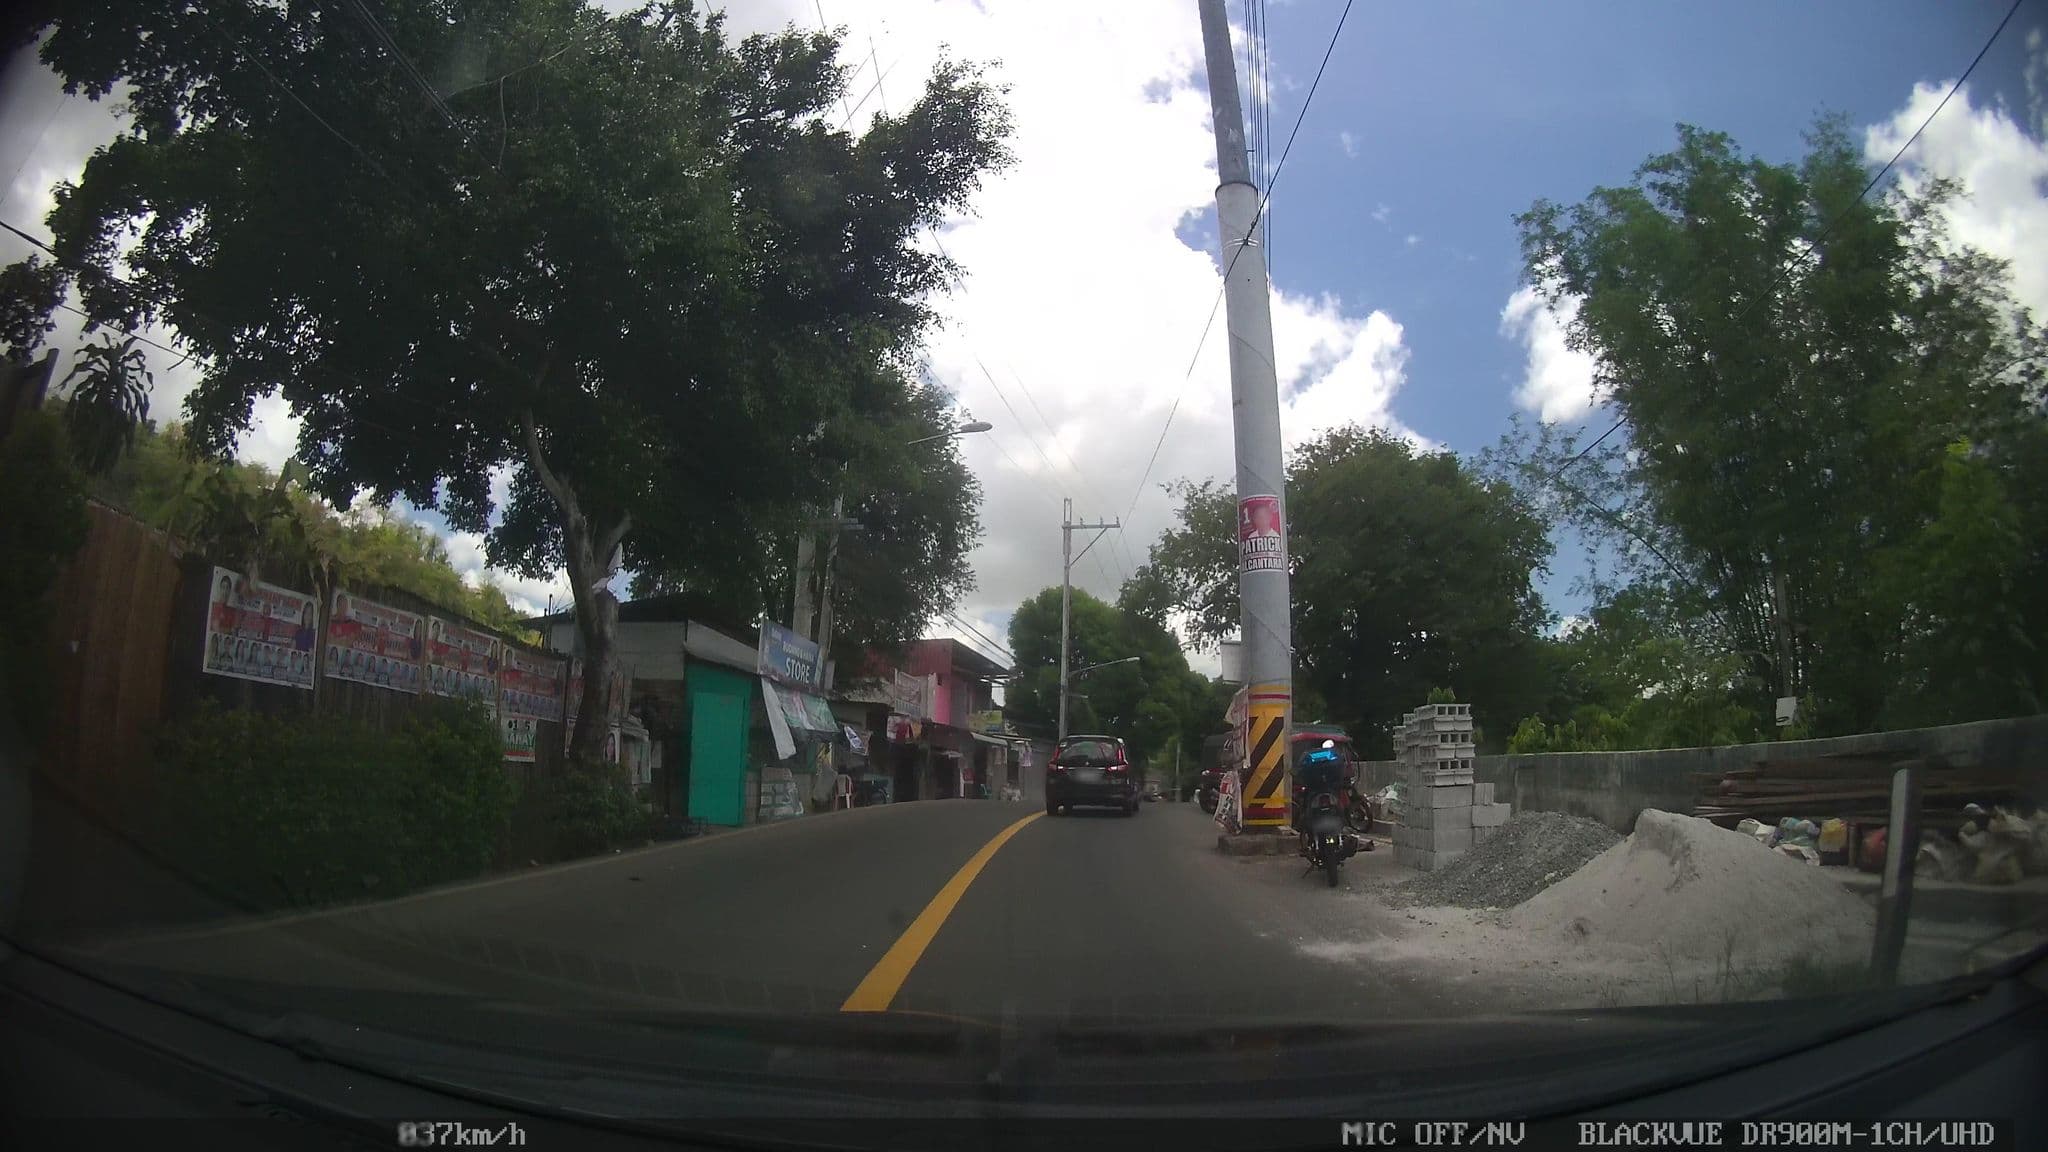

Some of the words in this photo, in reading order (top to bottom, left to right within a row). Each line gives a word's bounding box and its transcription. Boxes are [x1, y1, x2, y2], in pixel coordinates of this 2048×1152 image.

[1243, 507, 1250, 524] 1
[1241, 537, 1282, 555] PATRICK
[786, 657, 810, 684] STORE
